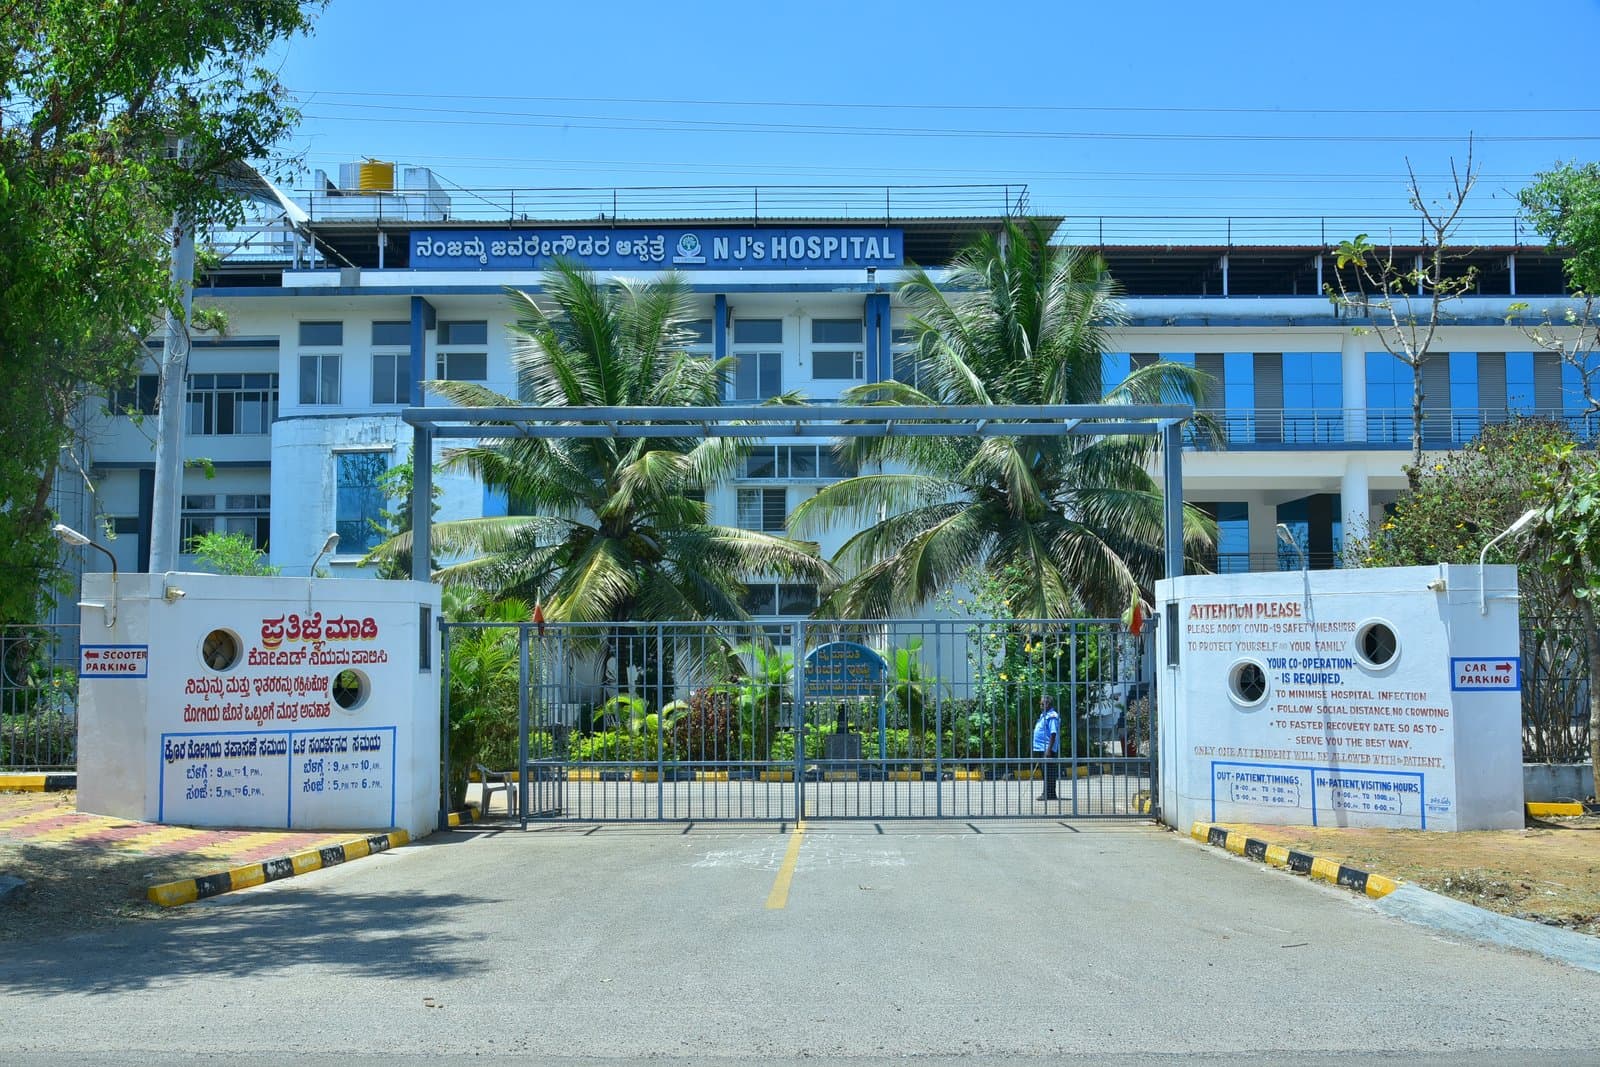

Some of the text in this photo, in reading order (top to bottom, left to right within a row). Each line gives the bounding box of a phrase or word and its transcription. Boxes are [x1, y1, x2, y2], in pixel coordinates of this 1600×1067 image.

[416, 235, 665, 264] ನಂಜಮ್ಮ ಜವರೇಗೌಡರ ಆಸ್ಪತ್ರೆ
[771, 236, 896, 260] HOSPITAL
[1256, 602, 1301, 619] PLEASE
[261, 611, 379, 651] ಪ್ರತಿಜ್ಞೆ ಮಾಡಿ
[1187, 624, 1215, 633] PLEASE
[1217, 623, 1242, 633] ADOPT
[1283, 622, 1315, 633] SAFETY
[1316, 621, 1357, 632] MEASURES
[1188, 641, 1197, 651] TO
[1199, 641, 1232, 651] PROTECT
[1235, 641, 1278, 652] YOURSELF
[1289, 641, 1311, 652] YOUR
[1314, 641, 1346, 652] FAMILY
[86, 650, 147, 671] SCOOTER PARKING
[248, 646, 388, 666] ಕೋವಿಡ್ ನಿಯಮ ಪಾಲಿಸಿ
[1266, 657, 1287, 669] YOUR
[1281, 672, 1345, 685] IS REQUIRED.
[1460, 663, 1510, 684] CAR PARKING
[226, 676, 251, 697] ಮತ್ತು
[1275, 689, 1427, 701] TO MINIMISE HOSPITAL INFECTION
[1277, 704, 1313, 714] FOLLOW
[1316, 705, 1348, 715] SOCIAL
[1392, 707, 1403, 716] NO
[1405, 707, 1450, 718] CROWDING
[1275, 720, 1437, 734] TO FASTER RECOVERY RATE SO AS TO
[259, 737, 288, 756] ಸಮಯ
[352, 733, 381, 752] ಸಮಯ
[1295, 735, 1412, 750] SERVE YOU THE BEST WAY.
[1361, 781, 1391, 792] VISITING
